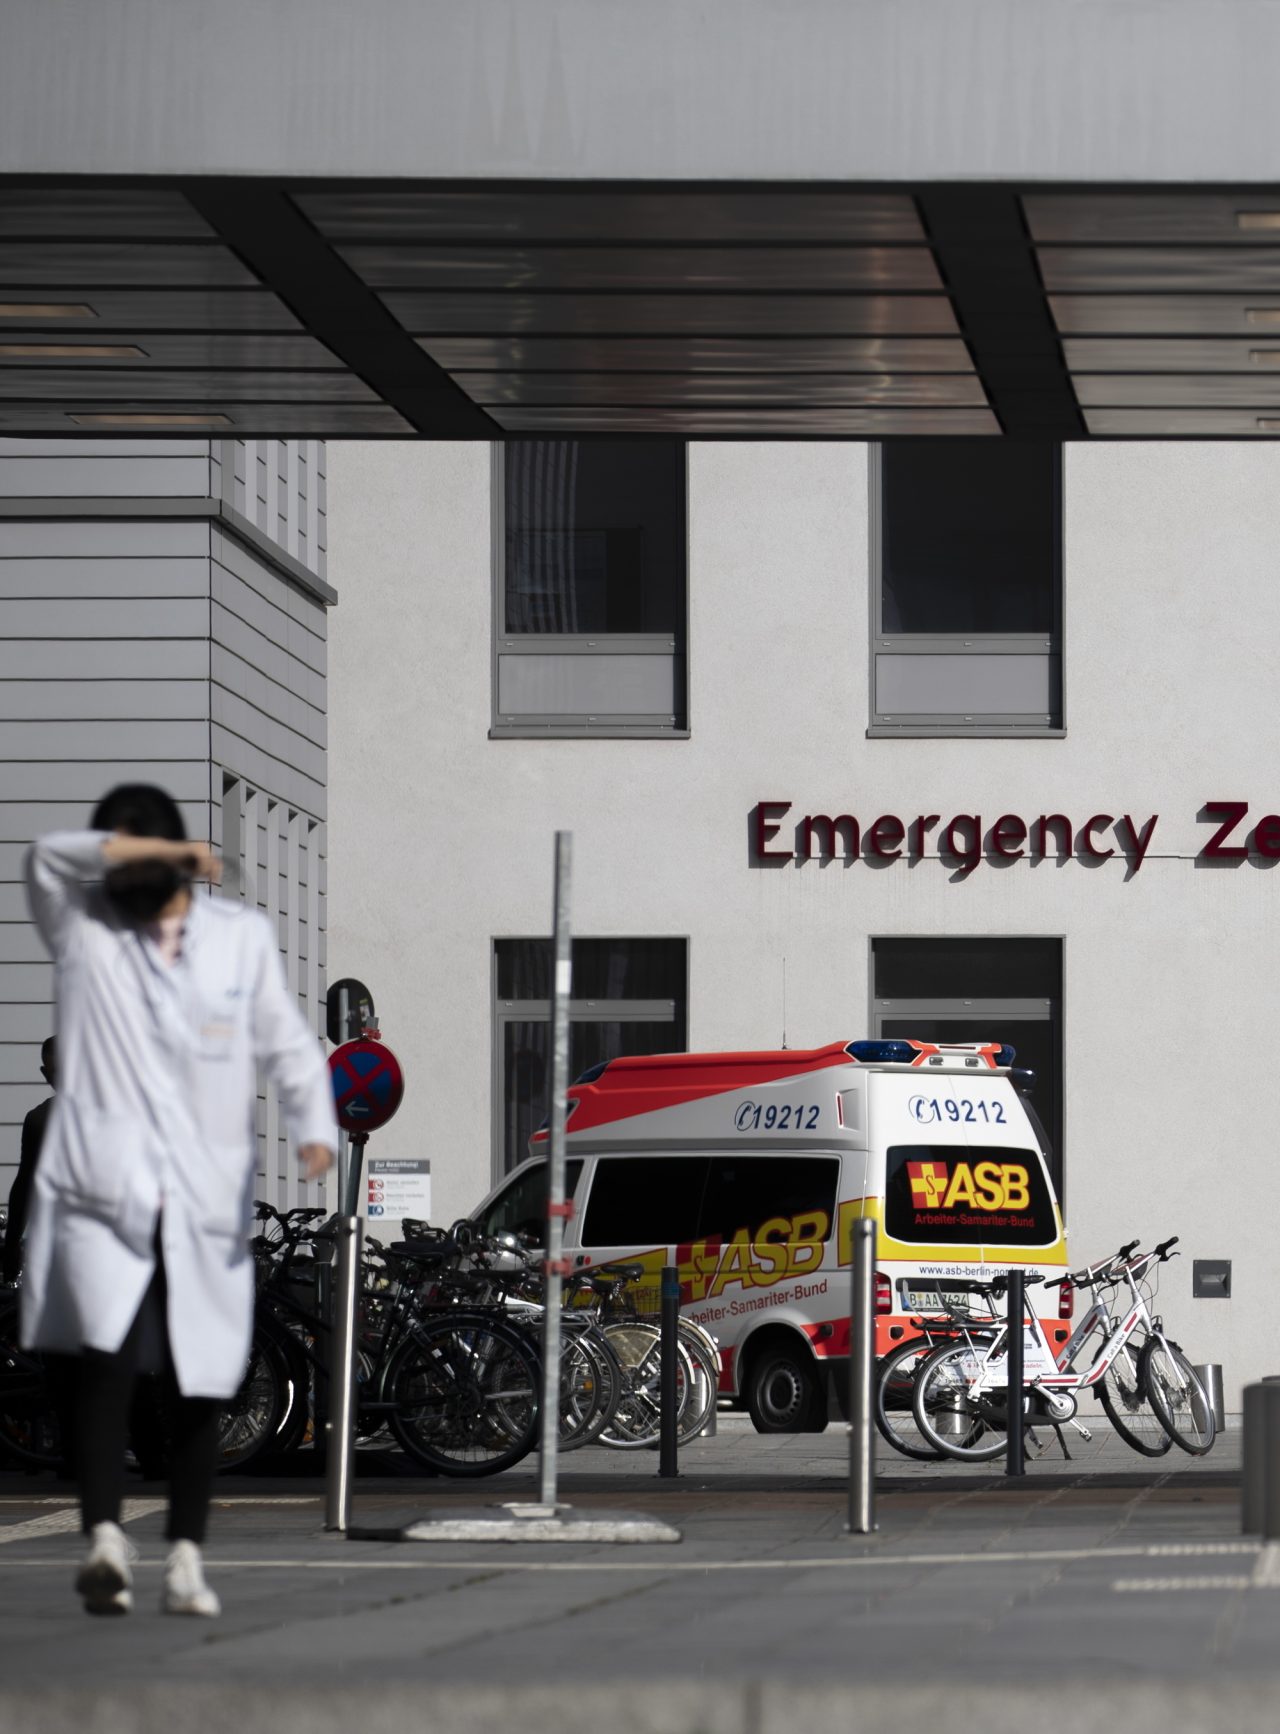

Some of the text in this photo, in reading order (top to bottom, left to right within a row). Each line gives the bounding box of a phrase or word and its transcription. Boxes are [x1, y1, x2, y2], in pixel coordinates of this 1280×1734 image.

[757, 801, 1158, 871] Emergency
[753, 1104, 820, 1130] 19212
[930, 1099, 1007, 1124] 19212
[942, 1161, 1030, 1211] ASB
[914, 1213, 1036, 1228] Arbeiter-Samariter-Bund
[708, 1210, 829, 1299] ASB
[687, 1278, 828, 1326] beiter-Samariter-Bund
